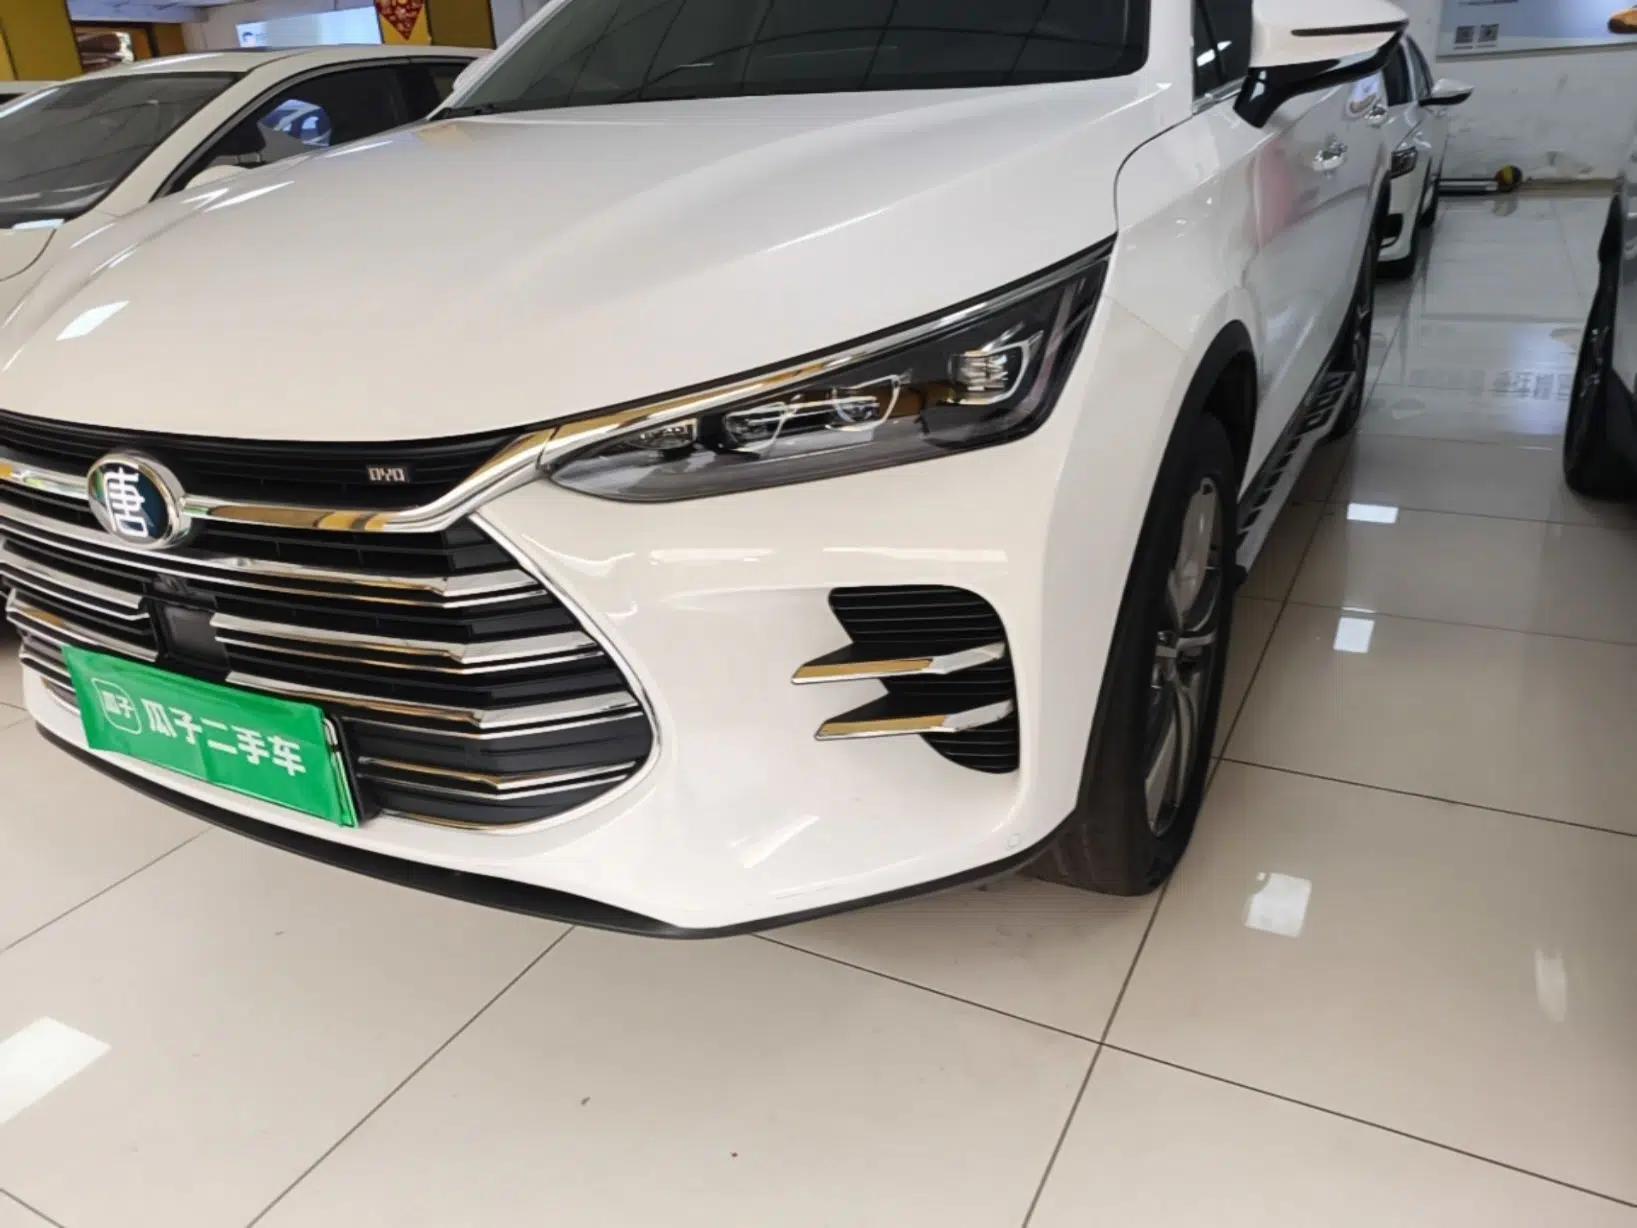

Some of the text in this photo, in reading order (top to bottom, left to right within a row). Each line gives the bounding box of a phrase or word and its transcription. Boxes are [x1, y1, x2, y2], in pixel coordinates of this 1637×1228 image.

[104, 466, 148, 537] 唐
[141, 698, 306, 776] 瓜子二手车
